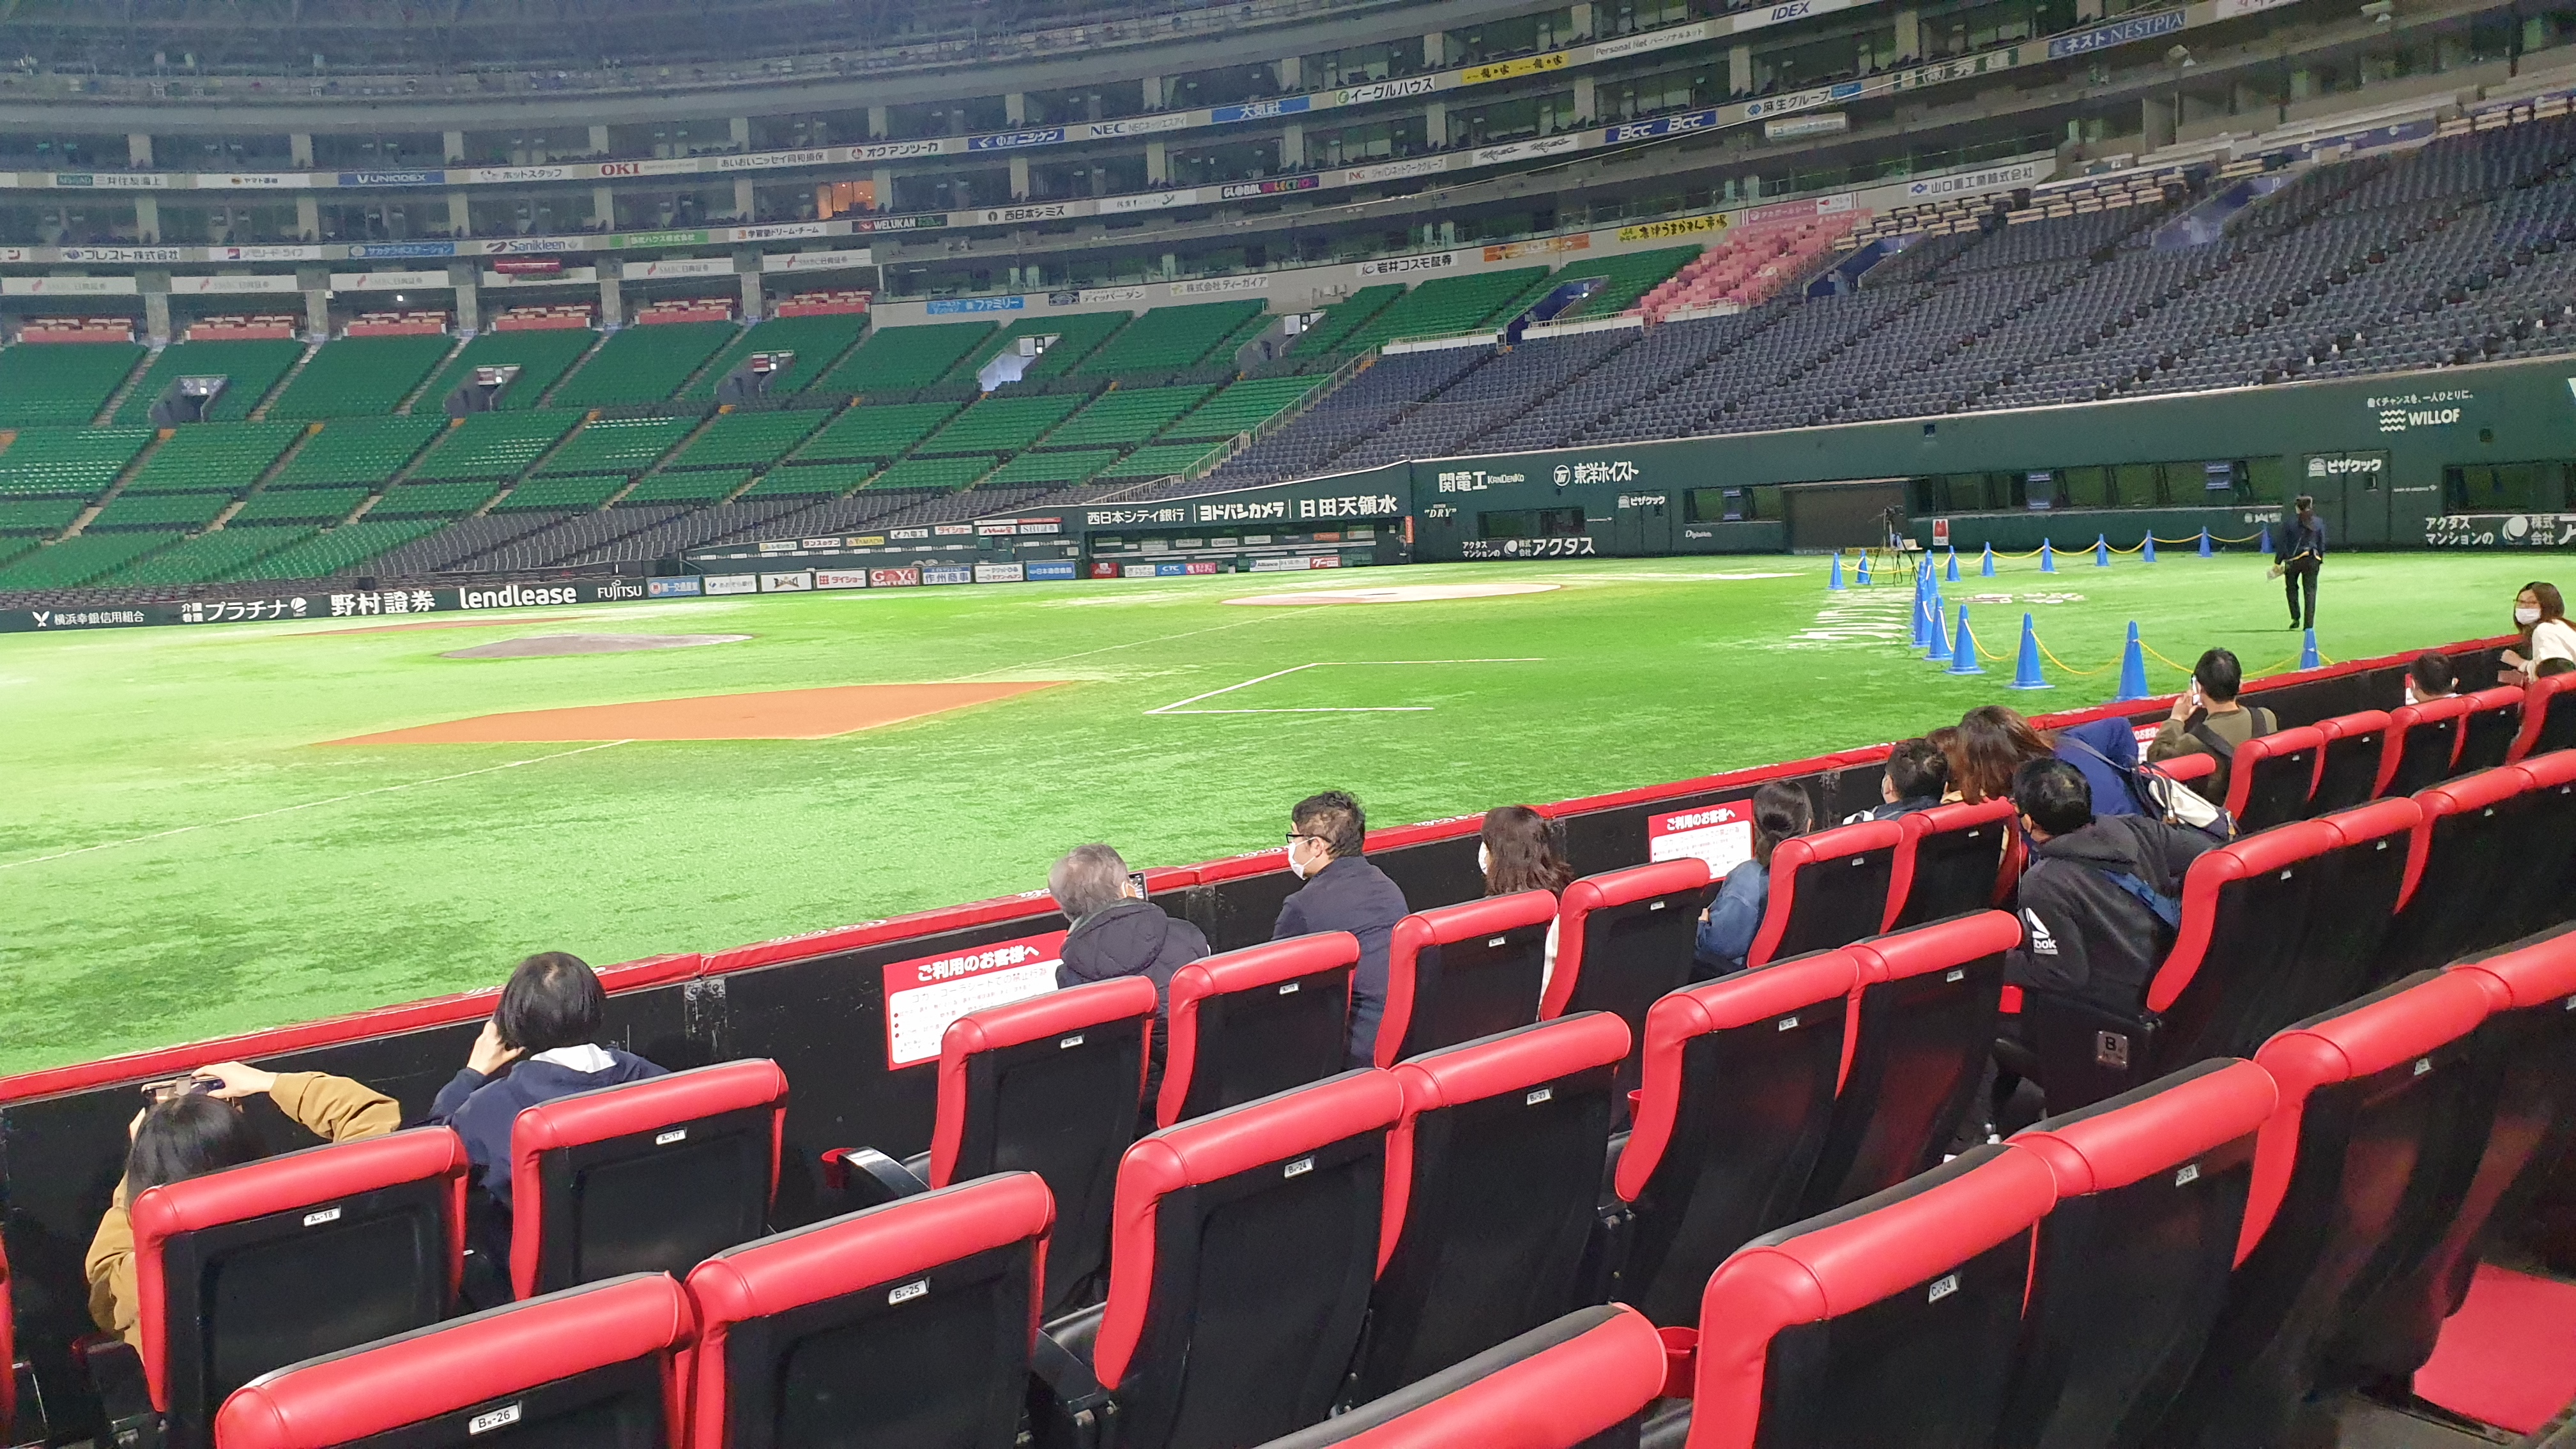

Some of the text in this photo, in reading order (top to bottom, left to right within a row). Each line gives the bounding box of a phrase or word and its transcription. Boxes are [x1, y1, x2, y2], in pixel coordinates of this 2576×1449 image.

[1771, 1, 1811, 21] IDEX
[2066, 12, 2183, 52] ネスト NESTPIA
[1596, 42, 1631, 56] Personal
[1350, 77, 1433, 102] イーグルハウス
[1763, 90, 1829, 114] 麻生グループ
[1091, 123, 1125, 136] NEC
[1618, 125, 1653, 140] BCC
[1667, 116, 1704, 133] BCC
[503, 169, 562, 180] ホットスタッフ
[601, 164, 639, 175] OKI
[1223, 183, 1261, 198] GLOBAL
[509, 240, 565, 252] Sanikleen
[1377, 254, 1452, 273] 岩井コスモ証券
[2408, 408, 2461, 426] WILLOF
[1574, 461, 1639, 484] 東洋ホイスト
[1439, 471, 1488, 493] 関電工
[1200, 501, 1284, 521] ヨドバシカメラ
[1300, 494, 1398, 518] 日田天領水
[1087, 508, 1184, 525] 西日本シティ銀行
[2425, 517, 2471, 530] アクタス
[1462, 541, 1488, 549] アクタス
[1533, 537, 1595, 556] アクタス
[2425, 532, 2494, 546] マンションの
[2531, 531, 2555, 546] 会社
[1462, 549, 1500, 558] マンションの
[831, 576, 863, 584] ダイショー
[459, 585, 576, 610] lendlease
[598, 579, 643, 601] FUJITSU
[206, 600, 288, 622] プラチナ
[331, 590, 436, 617] 野村證券
[54, 610, 144, 625] 横浜幸銀信用組合
[1667, 808, 1736, 831] ご利用のお客様へ
[917, 944, 1040, 981] ご利用のお客様へ
[1529, 1091, 1546, 1102] B-23
[661, 1131, 680, 1142] A-17
[1288, 1163, 1307, 1174] B-24
[2177, 1168, 2193, 1181] C-23
[310, 1211, 334, 1222] A-18
[894, 1284, 920, 1298] B-25
[1931, 1280, 1951, 1297] C-24
[479, 1409, 510, 1428] B-26
